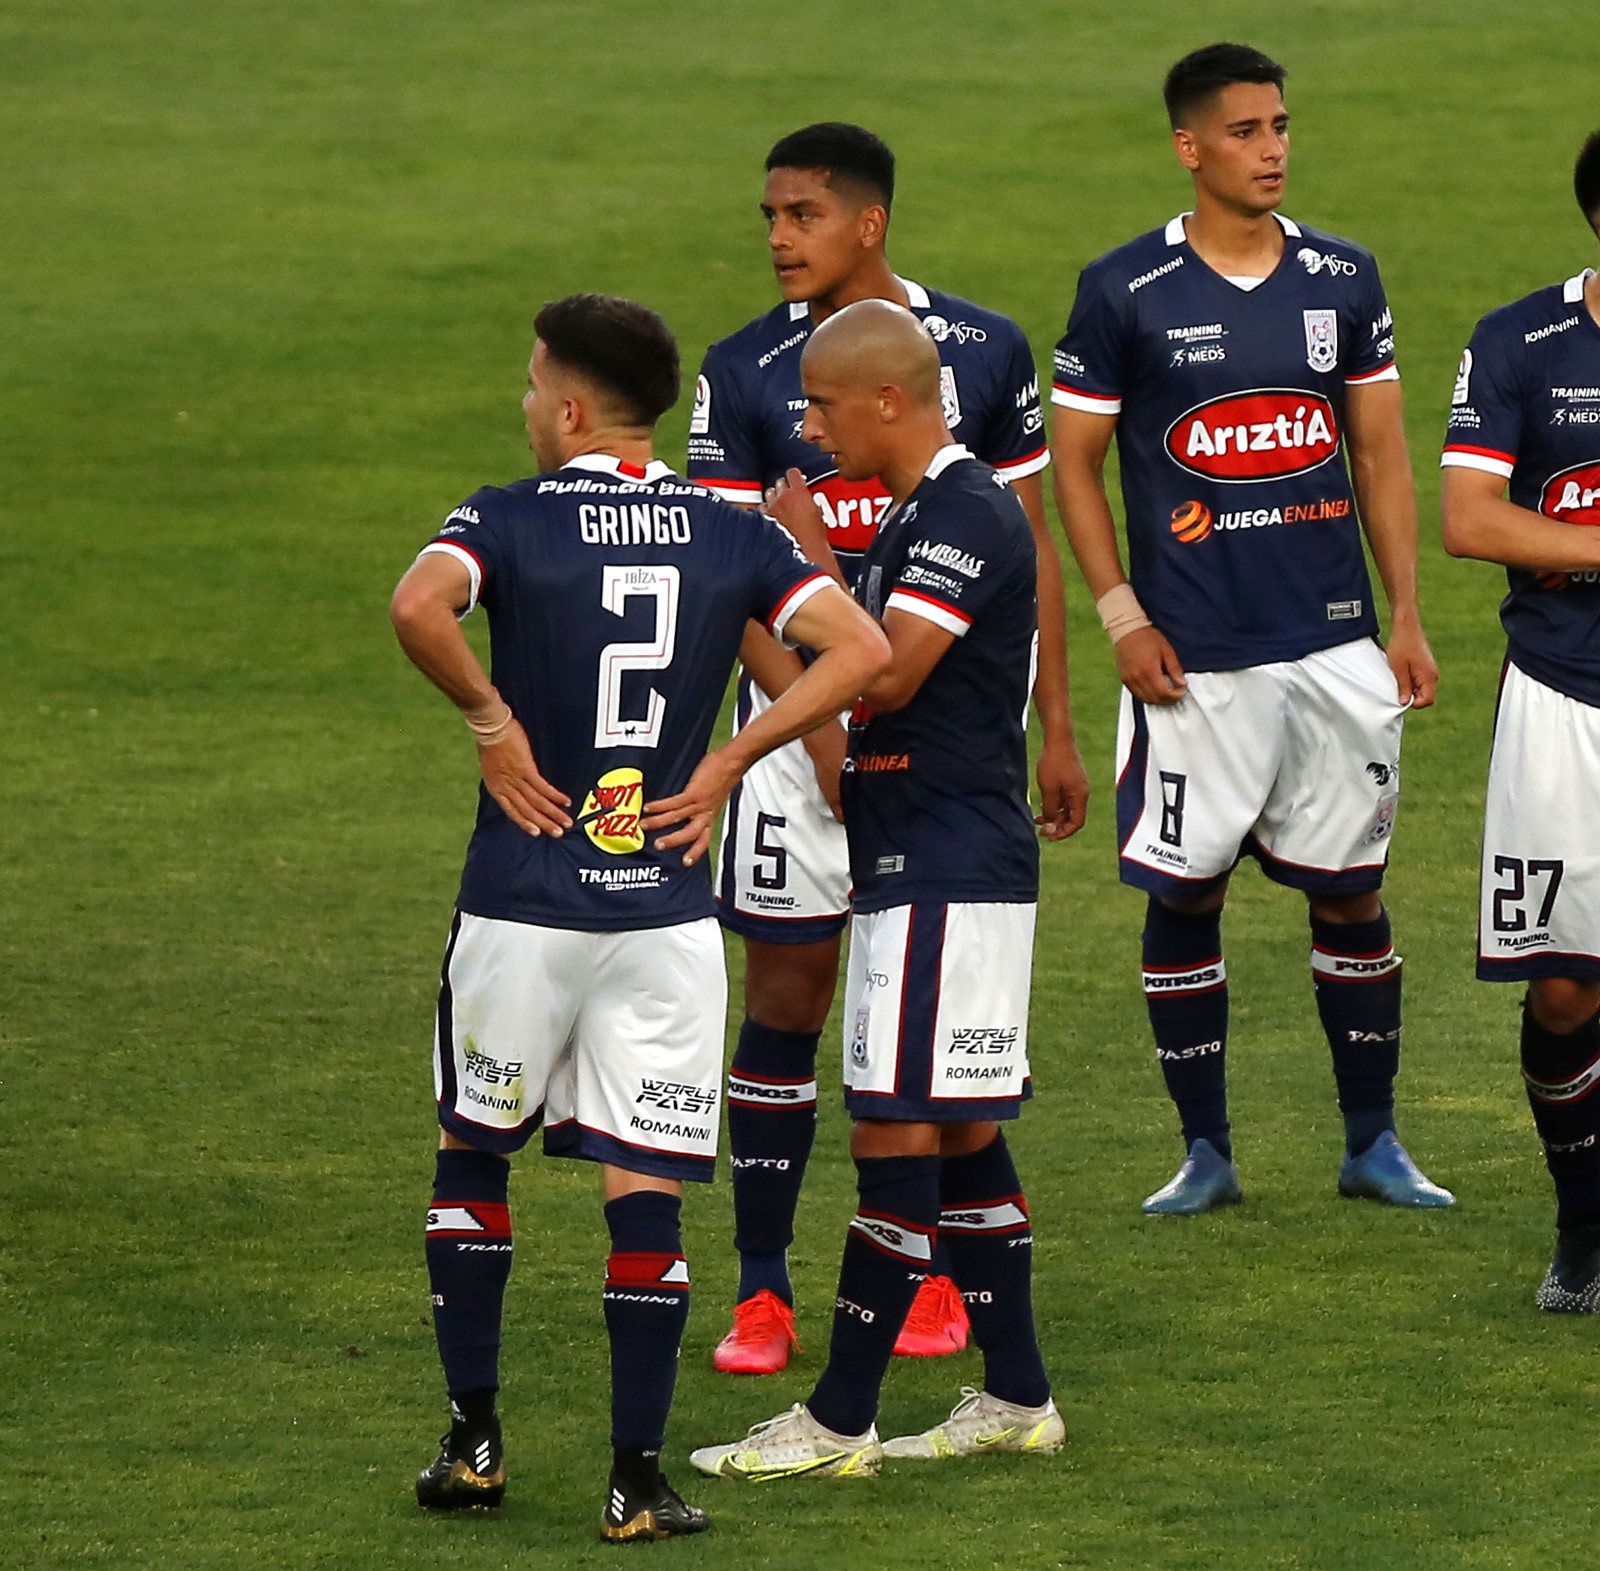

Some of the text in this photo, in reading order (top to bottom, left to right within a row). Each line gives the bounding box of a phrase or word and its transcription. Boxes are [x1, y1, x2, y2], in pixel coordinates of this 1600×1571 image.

[1166, 324, 1223, 340] TRAINING
[1188, 348, 1226, 363] MEDS
[578, 503, 691, 546] GRINGO
[594, 564, 682, 749] 2
[1159, 769, 1187, 847] 8
[752, 811, 787, 890] 5
[1145, 843, 1188, 866] TRAINING
[579, 866, 662, 883] TRAINING
[745, 892, 795, 906] TRAINING
[1493, 855, 1564, 932] 27
[1497, 932, 1550, 947] TRAINING
[951, 1026, 1019, 1041] WORLD
[948, 1040, 1016, 1055] FAST
[463, 1048, 523, 1074] WORLD
[465, 1060, 521, 1088] FAST
[946, 1065, 1013, 1081] ROMANINI
[464, 1085, 519, 1112] ROMANINI
[641, 1077, 718, 1100] WORLD
[635, 1092, 715, 1116] FAST
[630, 1115, 711, 1142] ROMANINI
